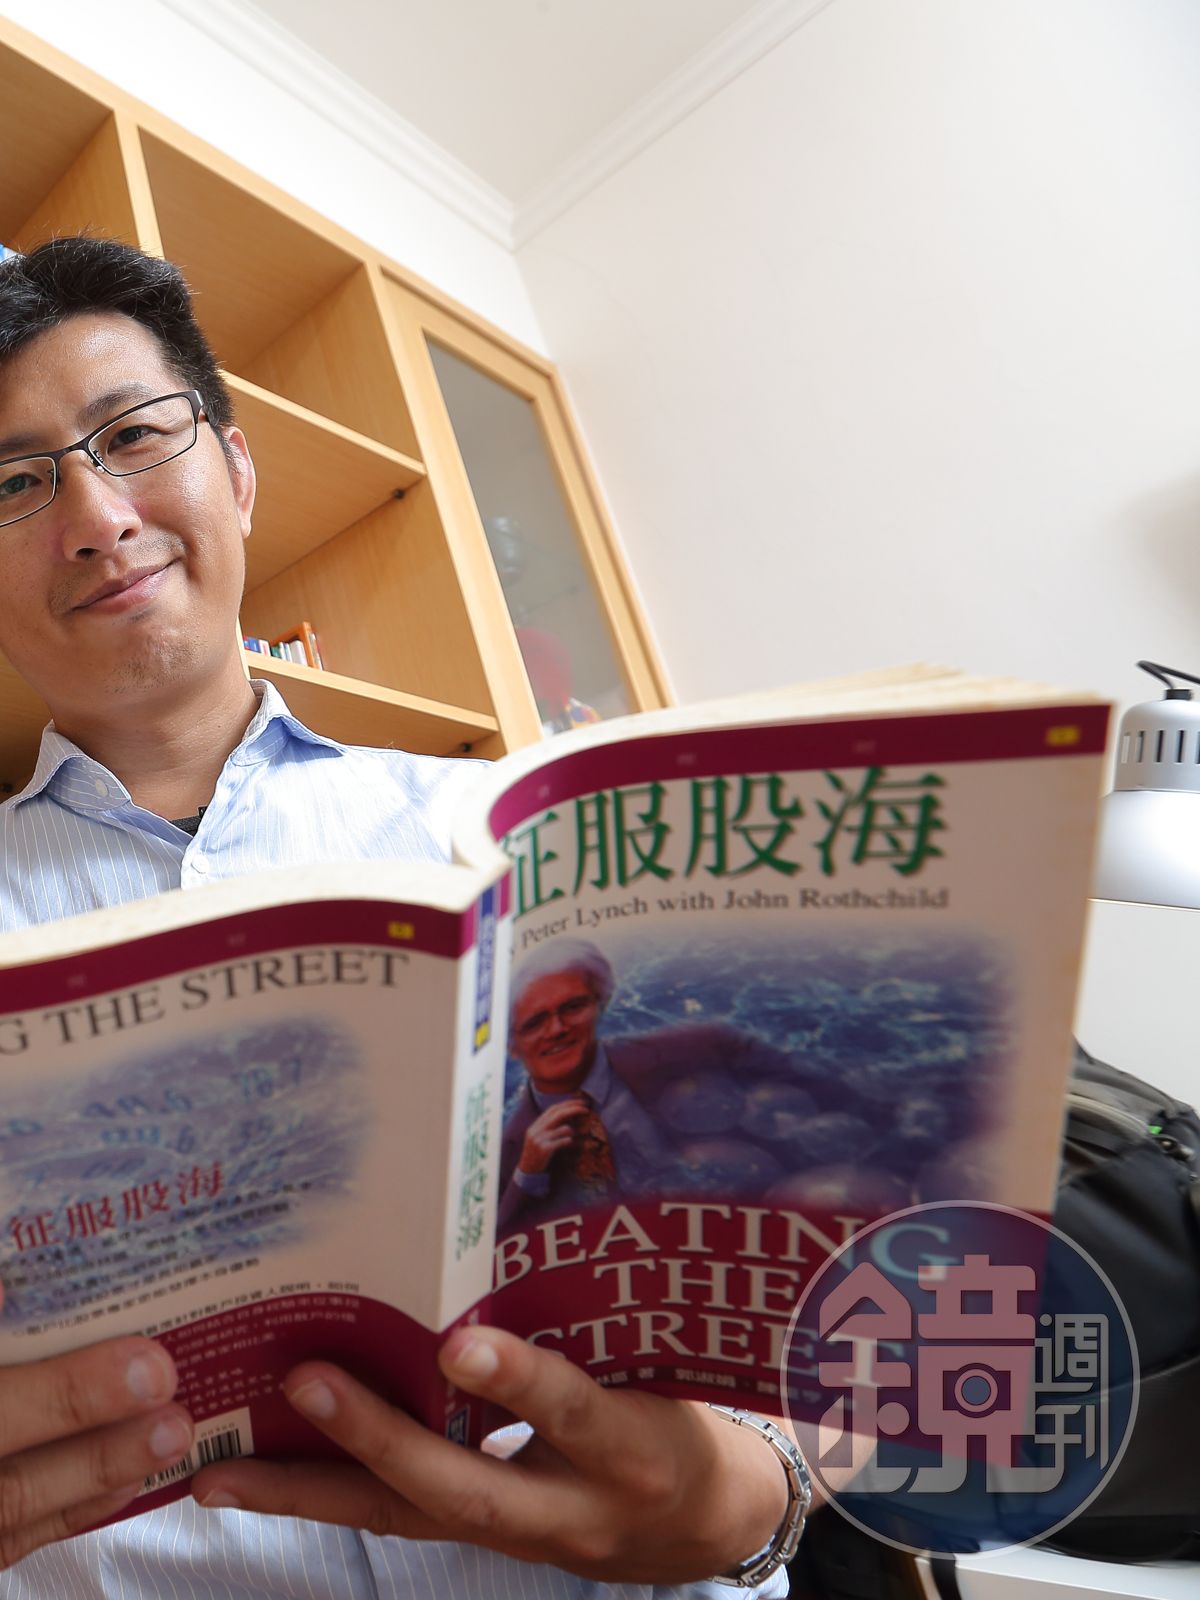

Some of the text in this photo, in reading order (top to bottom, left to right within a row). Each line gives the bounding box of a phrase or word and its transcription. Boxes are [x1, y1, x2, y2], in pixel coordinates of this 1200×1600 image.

[502, 765, 950, 923] 征服股海
[522, 915, 570, 950] Peter
[575, 892, 649, 929] Lynch
[657, 891, 715, 913] with
[722, 889, 789, 910] John
[43, 987, 167, 1049] THE
[181, 947, 412, 1012] STREET
[8, 1160, 228, 1257] 征服股海
[492, 1200, 960, 1294] BEATING
[593, 1257, 803, 1319] THE
